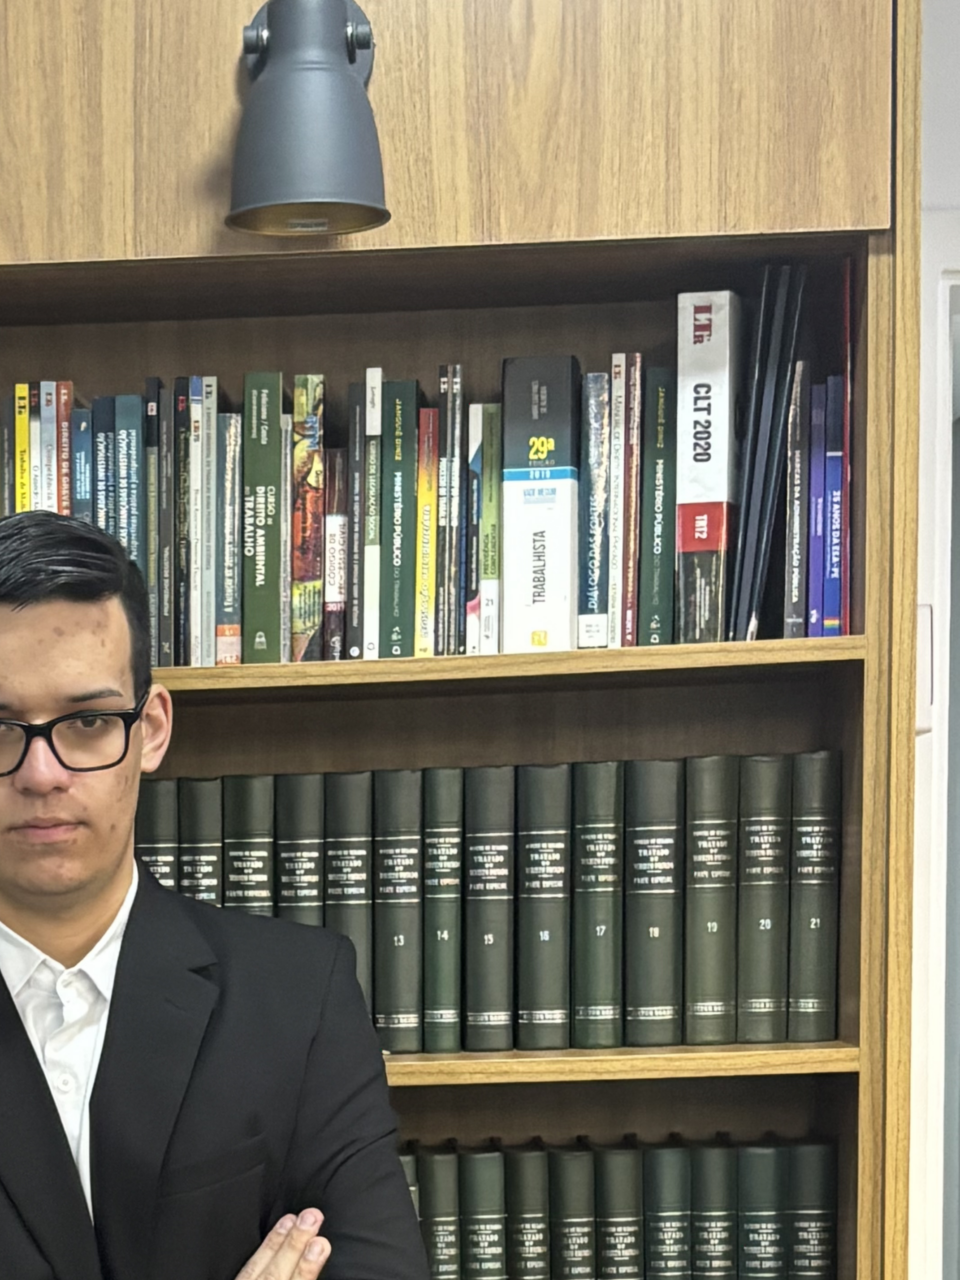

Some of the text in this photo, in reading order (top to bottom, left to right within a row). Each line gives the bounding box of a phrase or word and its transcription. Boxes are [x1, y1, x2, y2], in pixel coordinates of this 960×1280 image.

[693, 382, 712, 463] CLT 2020
[528, 437, 555, 460] 29ª
[255, 486, 266, 526] DIREITO
[266, 486, 276, 515] CURSO
[244, 496, 255, 557] TRABALHO
[393, 471, 404, 567] MINISTÉRIO PÚBLICO
[694, 514, 708, 539] TRT2
[531, 529, 547, 605] TRABALHISTA
[595, 925, 607, 936] 17
[707, 922, 718, 933] 19
[759, 918, 772, 930] 20
[810, 918, 821, 929] 21
[393, 935, 404, 947] 13
[436, 930, 449, 941] 14
[483, 934, 494, 945] 15
